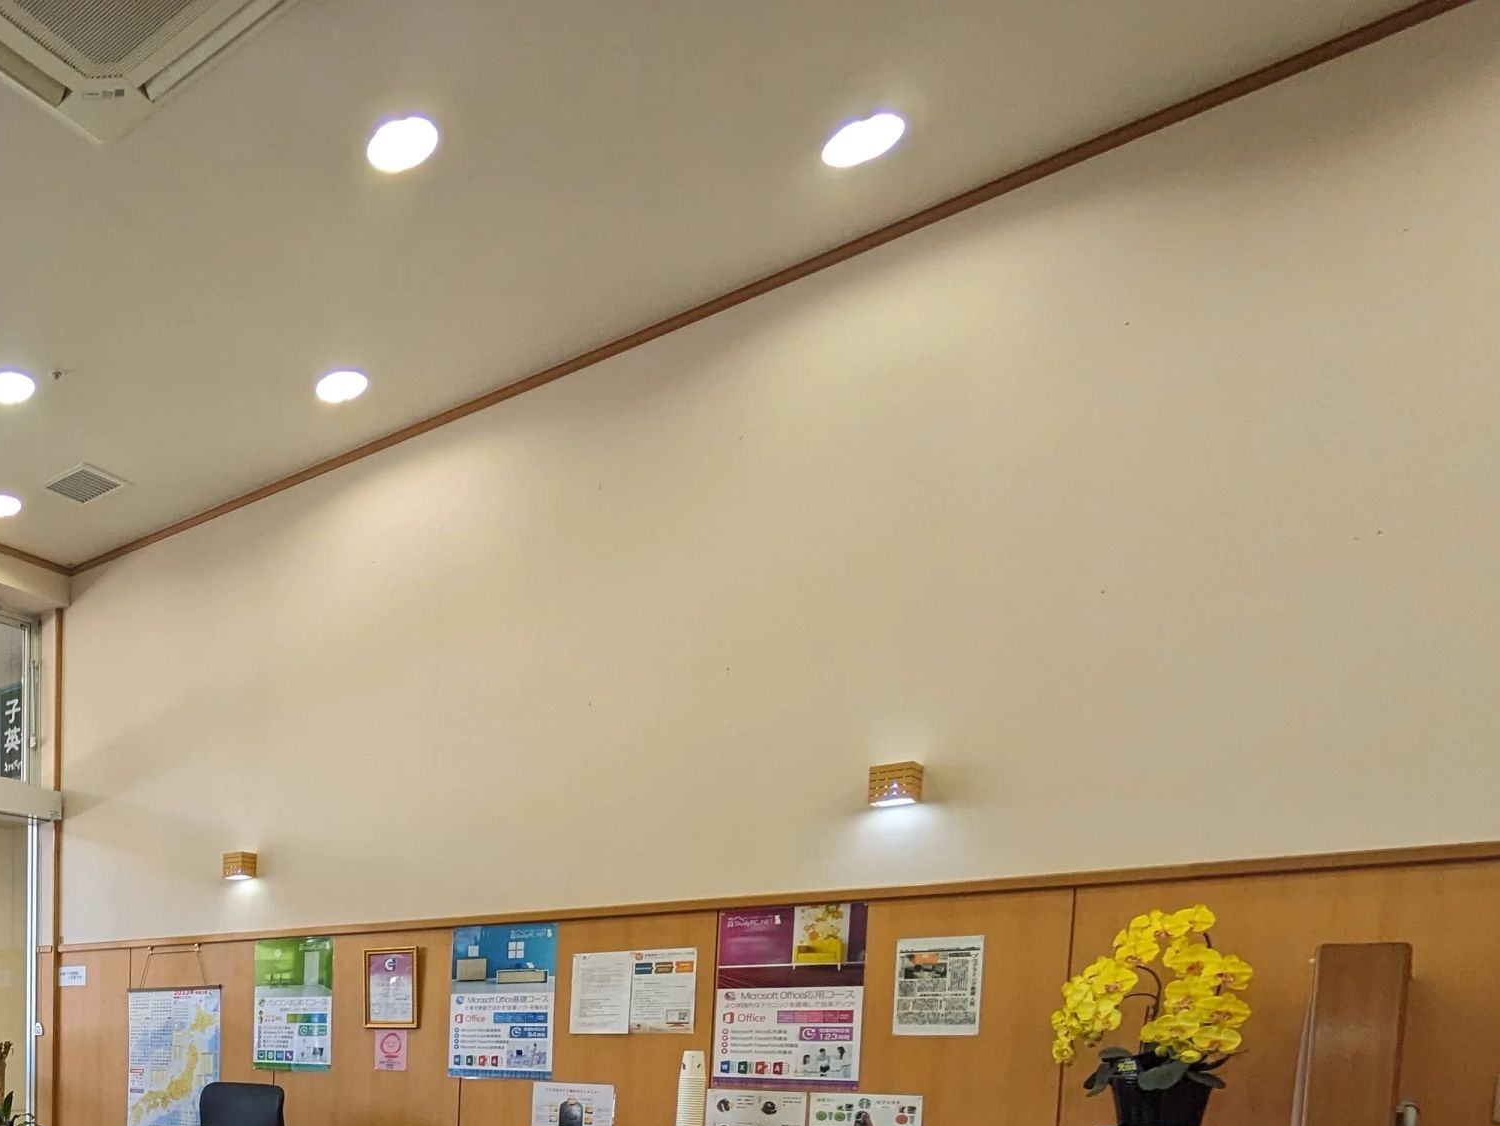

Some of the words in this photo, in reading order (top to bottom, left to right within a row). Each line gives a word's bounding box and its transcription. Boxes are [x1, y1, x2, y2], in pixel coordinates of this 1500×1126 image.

[467, 996, 494, 1004] Microsoft
[740, 991, 779, 1001] Microsoft
[465, 1014, 485, 1023] Office
[737, 1013, 766, 1023] Office
